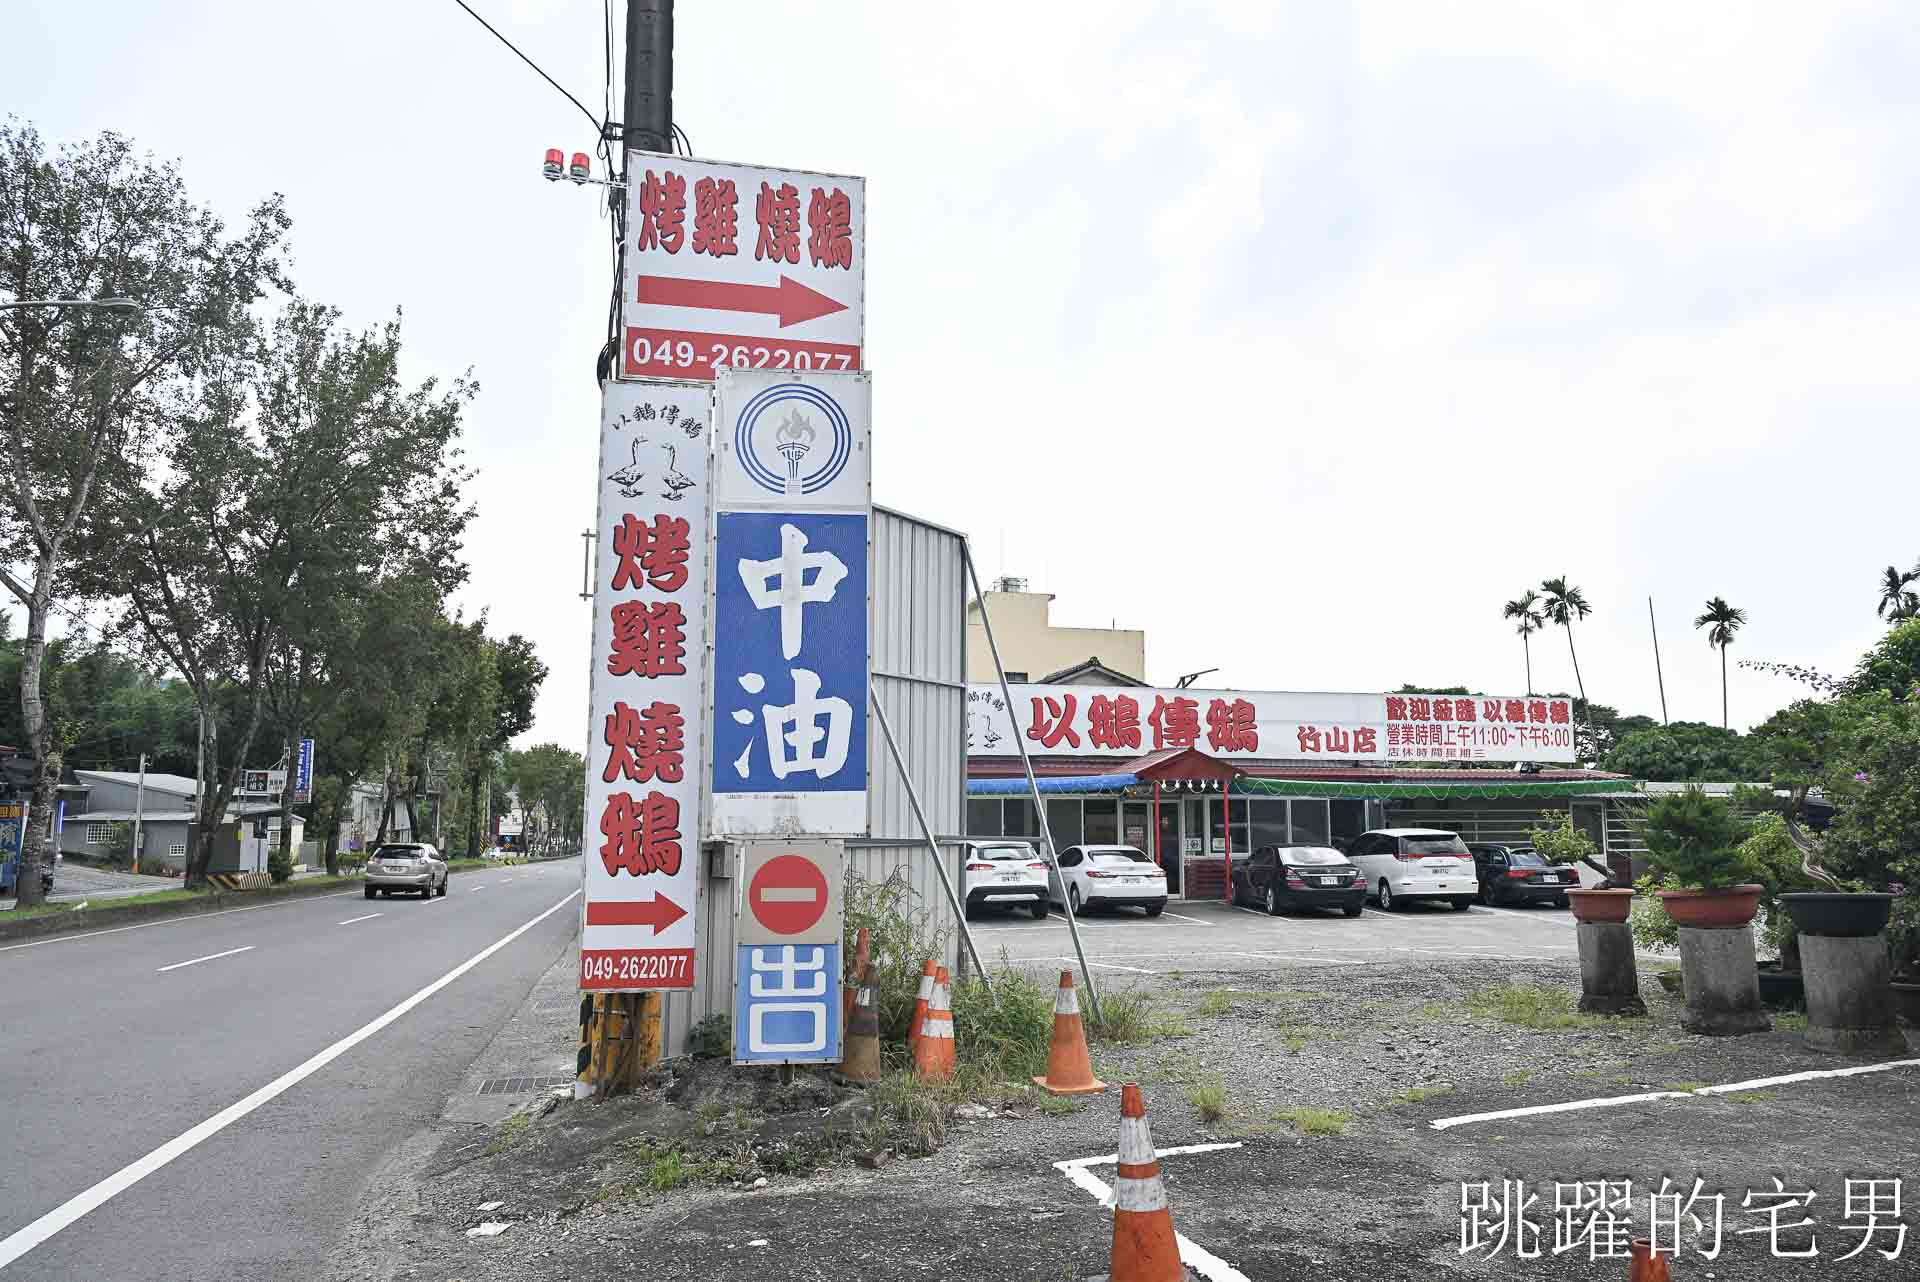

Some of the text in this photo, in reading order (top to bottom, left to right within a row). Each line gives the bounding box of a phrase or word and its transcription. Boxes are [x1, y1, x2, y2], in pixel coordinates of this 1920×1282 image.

[633, 337, 853, 371] 049-2622077
[731, 523, 853, 780] 中油
[1027, 693, 1258, 753] 以鵝傳鵝
[1297, 726, 1377, 753] 竹山店
[584, 955, 688, 980] 049-2622077
[749, 945, 827, 1053] 出口
